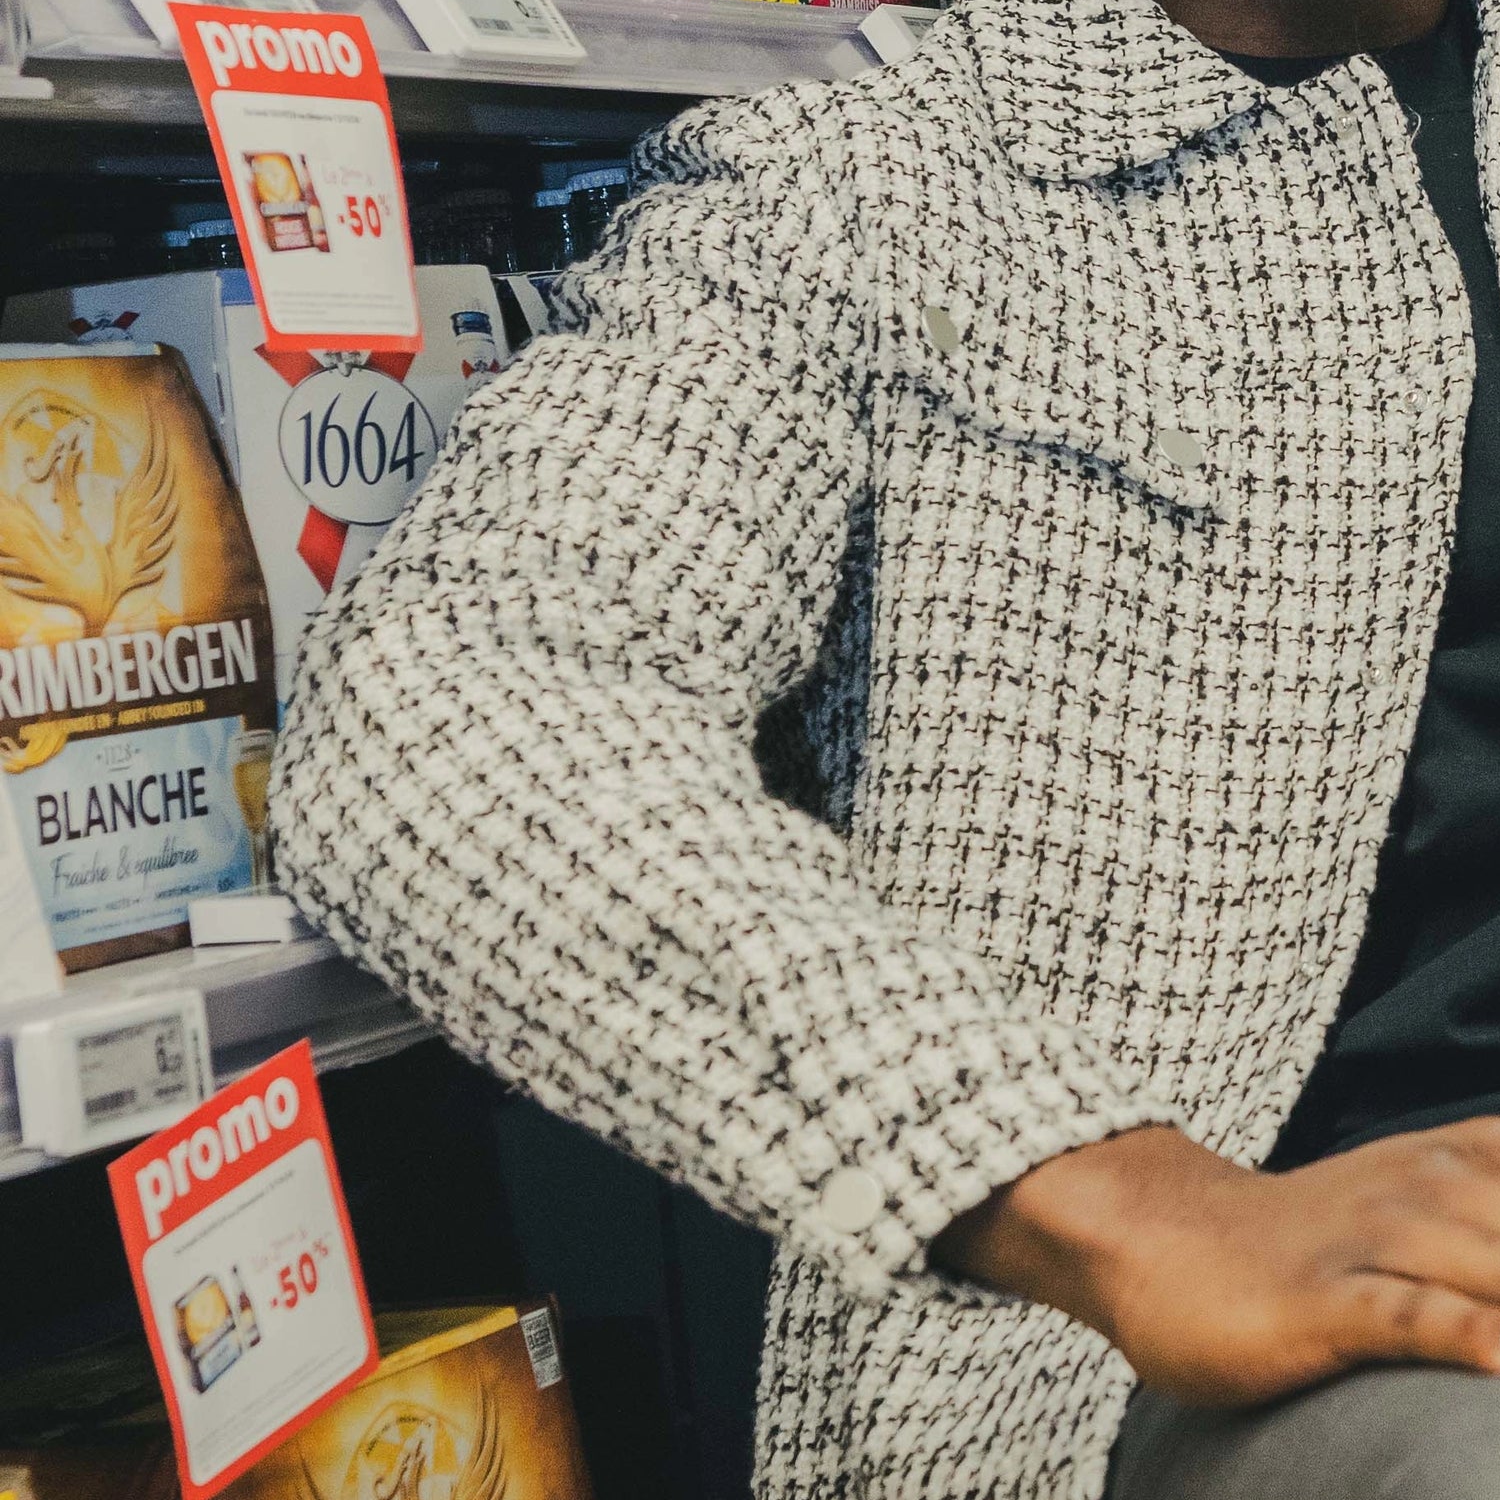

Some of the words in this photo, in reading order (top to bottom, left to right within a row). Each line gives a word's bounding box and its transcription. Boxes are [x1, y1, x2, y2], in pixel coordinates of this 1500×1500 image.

[195, 20, 363, 87] promo
[298, 391, 426, 491] 1664
[36, 766, 209, 847] BLANCHE
[134, 1076, 300, 1241] promo
[270, 1243, 329, 1310] -50%
